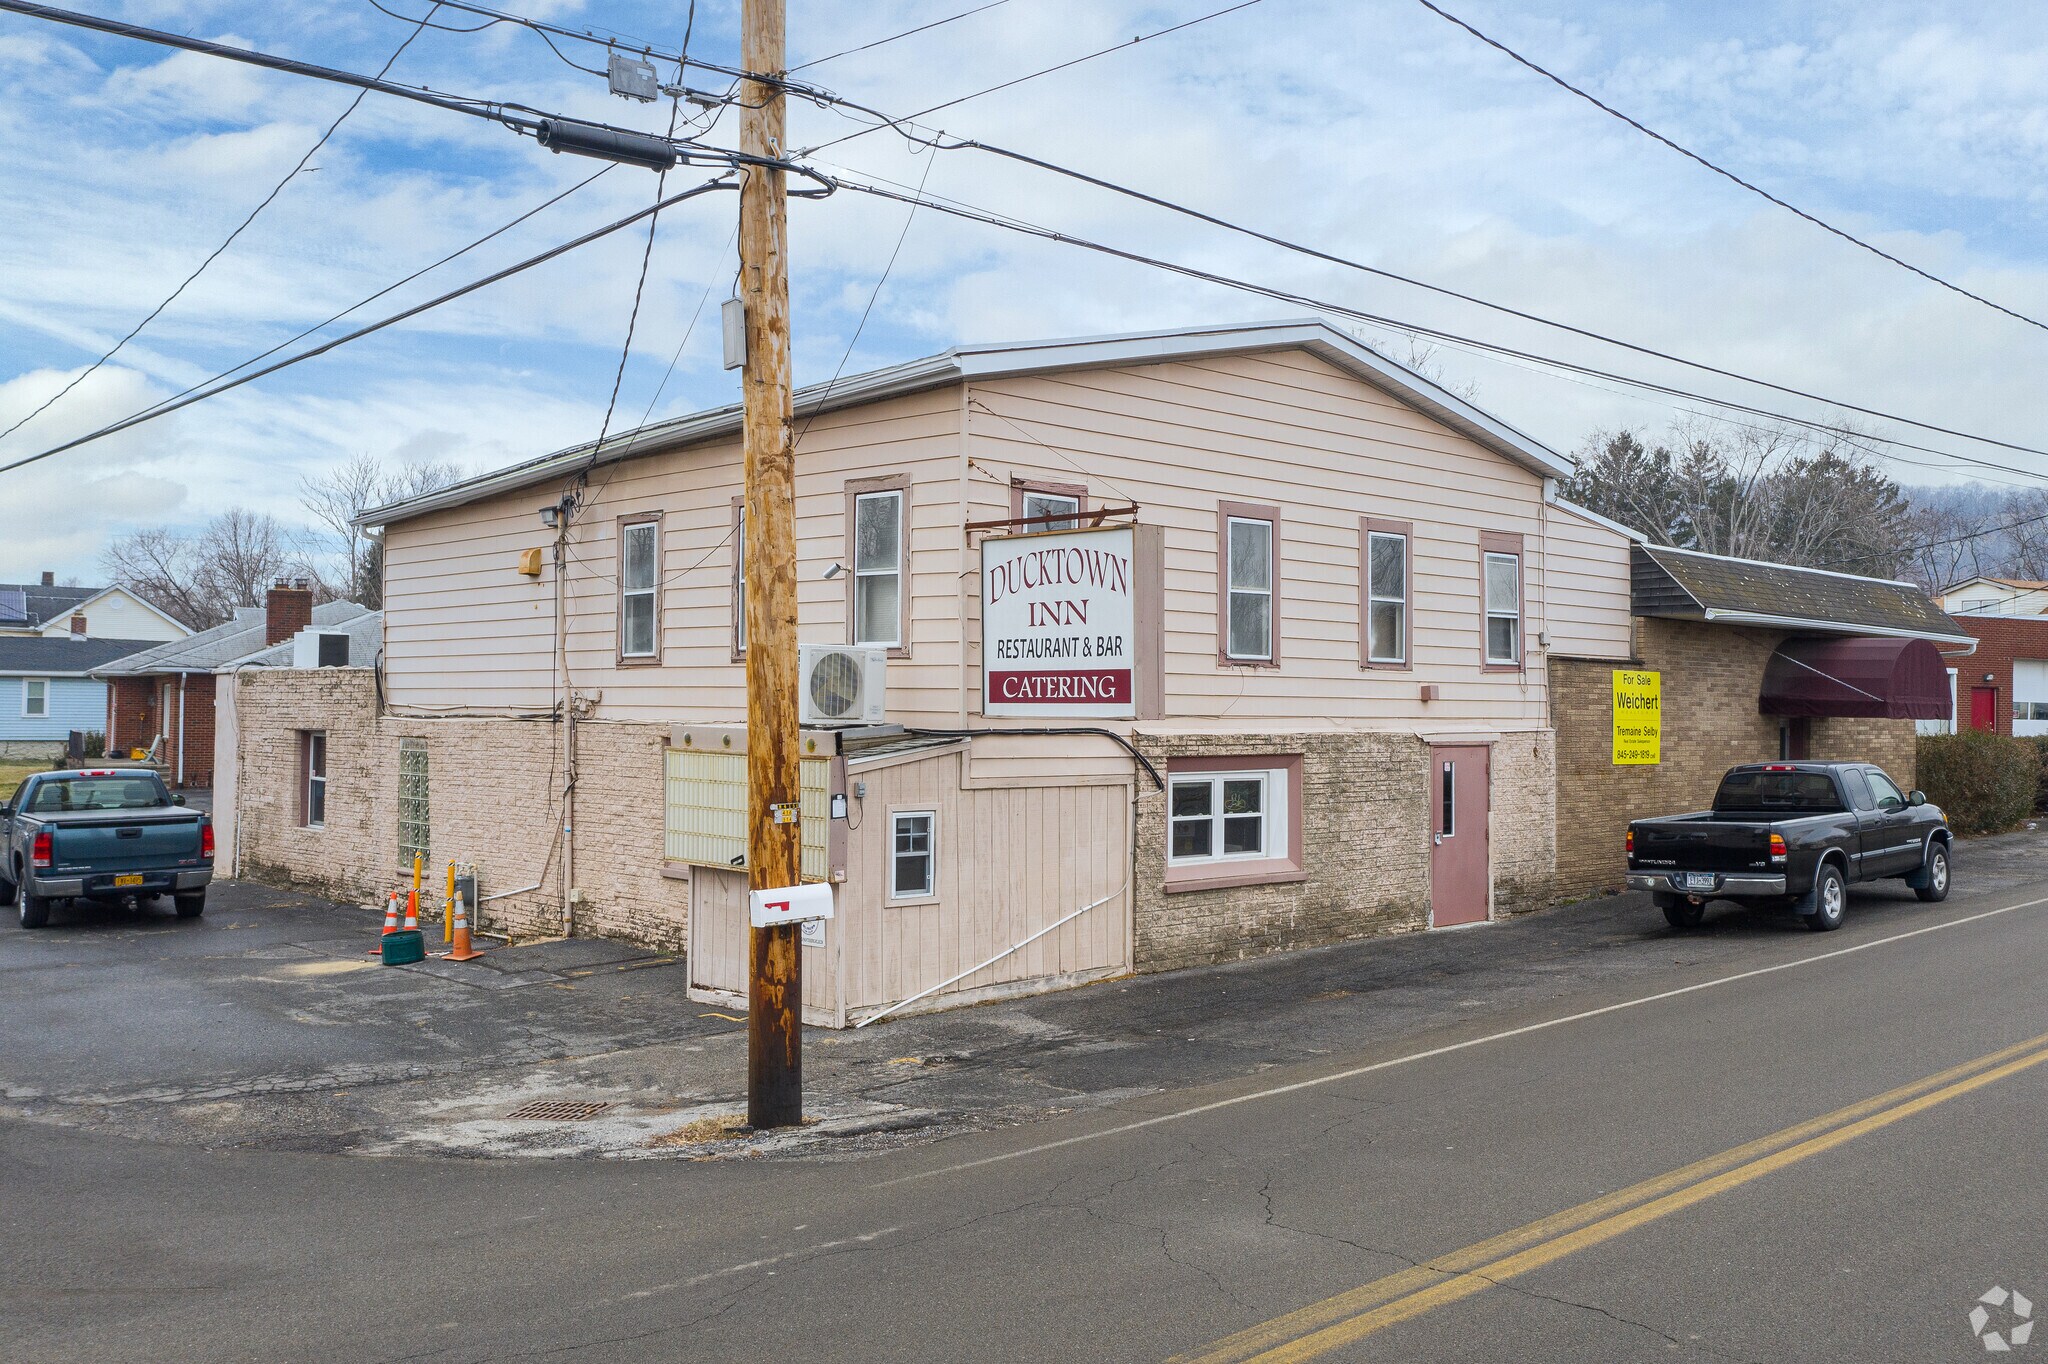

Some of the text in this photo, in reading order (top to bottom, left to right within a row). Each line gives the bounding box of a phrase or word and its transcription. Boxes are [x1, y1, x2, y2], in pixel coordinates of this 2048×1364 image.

[990, 547, 1128, 606] DUCKTOWN
[1027, 599, 1090, 628] INN
[997, 635, 1123, 659] RESTAURANT & BAR
[1002, 675, 1116, 699] CATERING
[1623, 673, 1651, 686] For Sale
[1616, 692, 1658, 710] Weichert
[1616, 725, 1658, 738] Tremaine Selby
